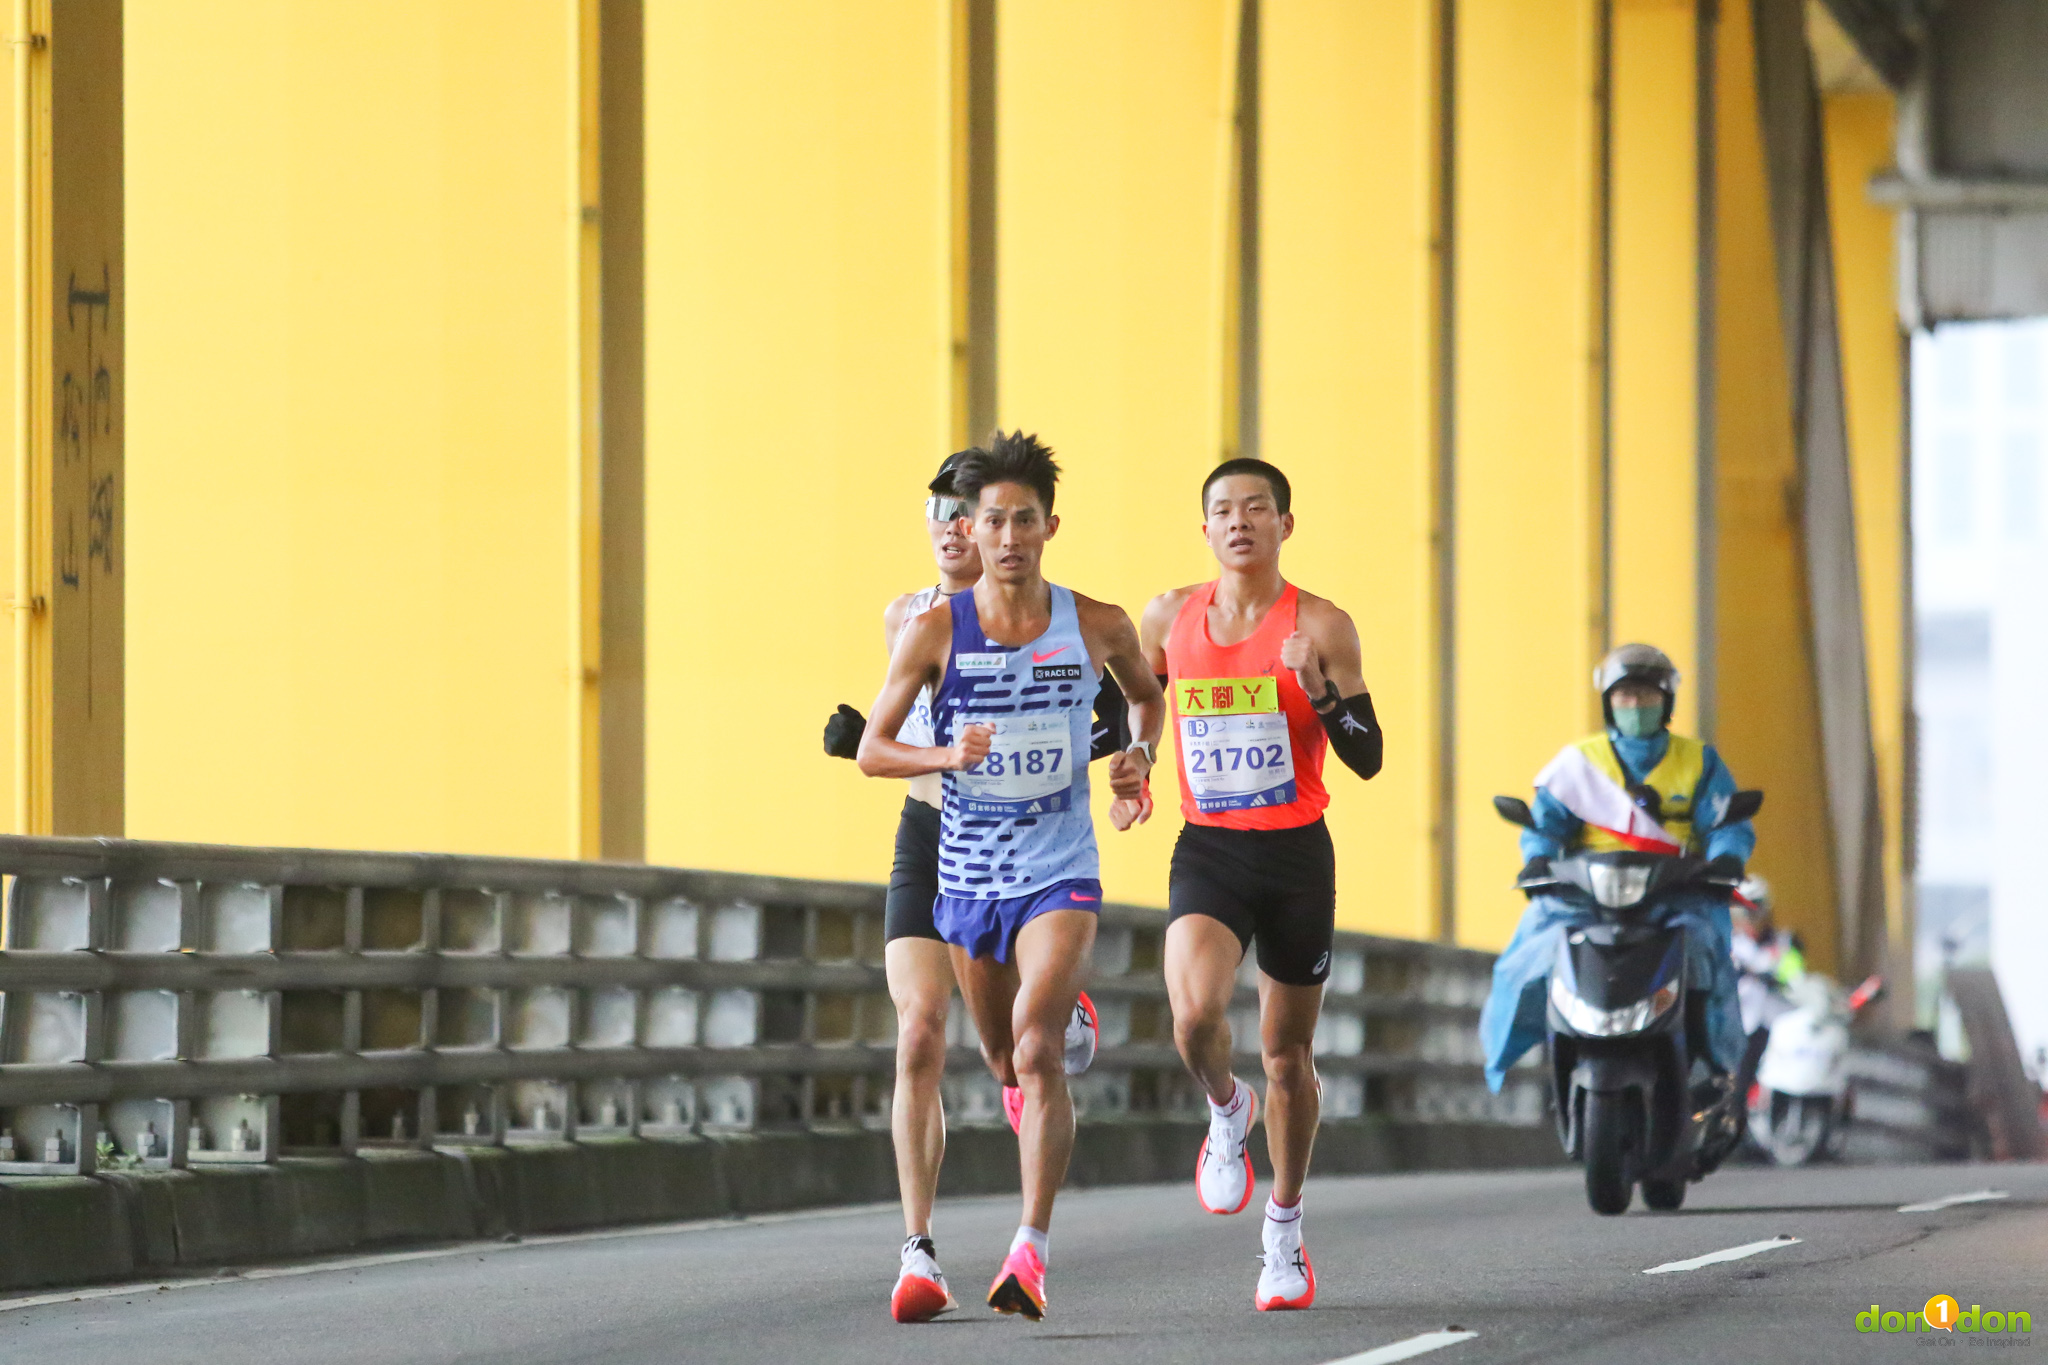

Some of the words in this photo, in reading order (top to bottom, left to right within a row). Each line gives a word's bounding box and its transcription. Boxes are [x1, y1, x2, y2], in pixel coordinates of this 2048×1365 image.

[1045, 669, 1066, 678] RACE
[1067, 668, 1080, 677] ON
[1184, 684, 1262, 710] 大腳丫
[1191, 744, 1285, 773] 21702
